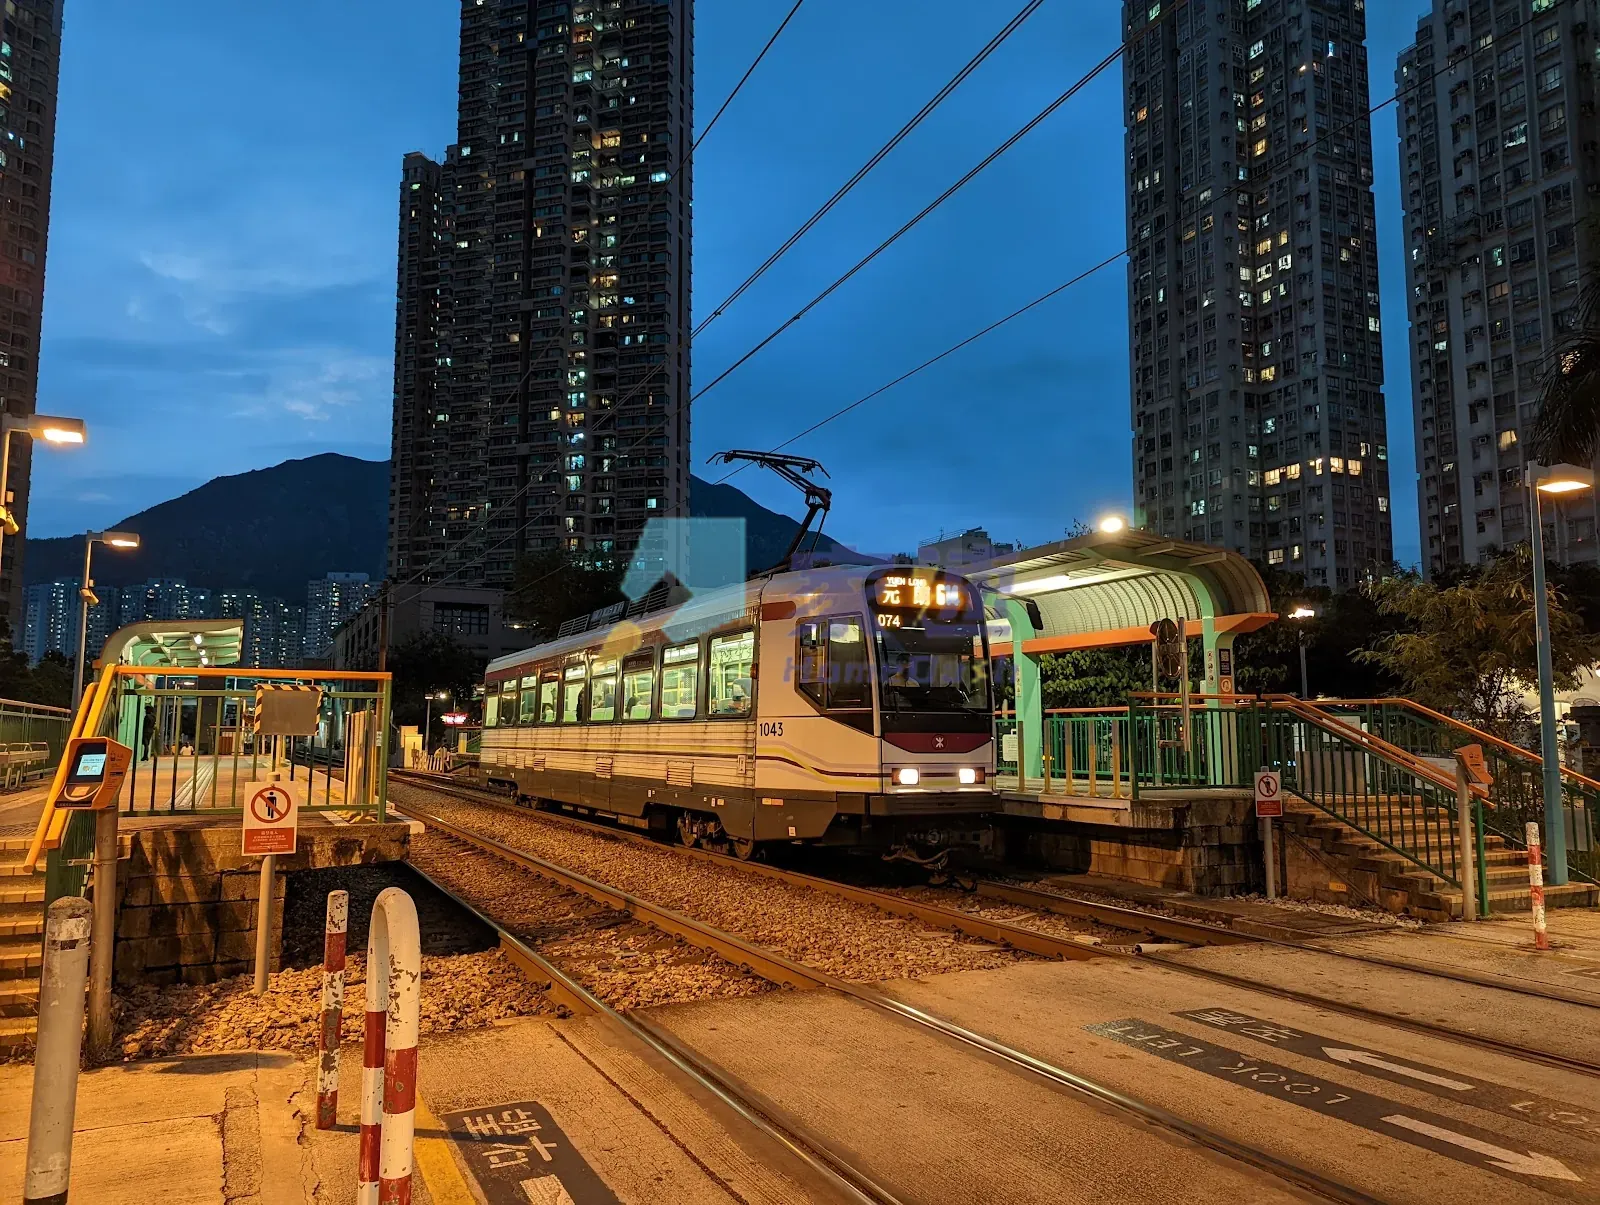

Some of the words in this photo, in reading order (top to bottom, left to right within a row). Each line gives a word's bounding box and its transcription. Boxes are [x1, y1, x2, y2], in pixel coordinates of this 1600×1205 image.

[877, 613, 901, 628] 074
[759, 722, 784, 737] 1043
[1107, 1026, 1205, 1057] LEFT
[1219, 1061, 1352, 1105] LOOK
[1510, 1101, 1600, 1134] LO
